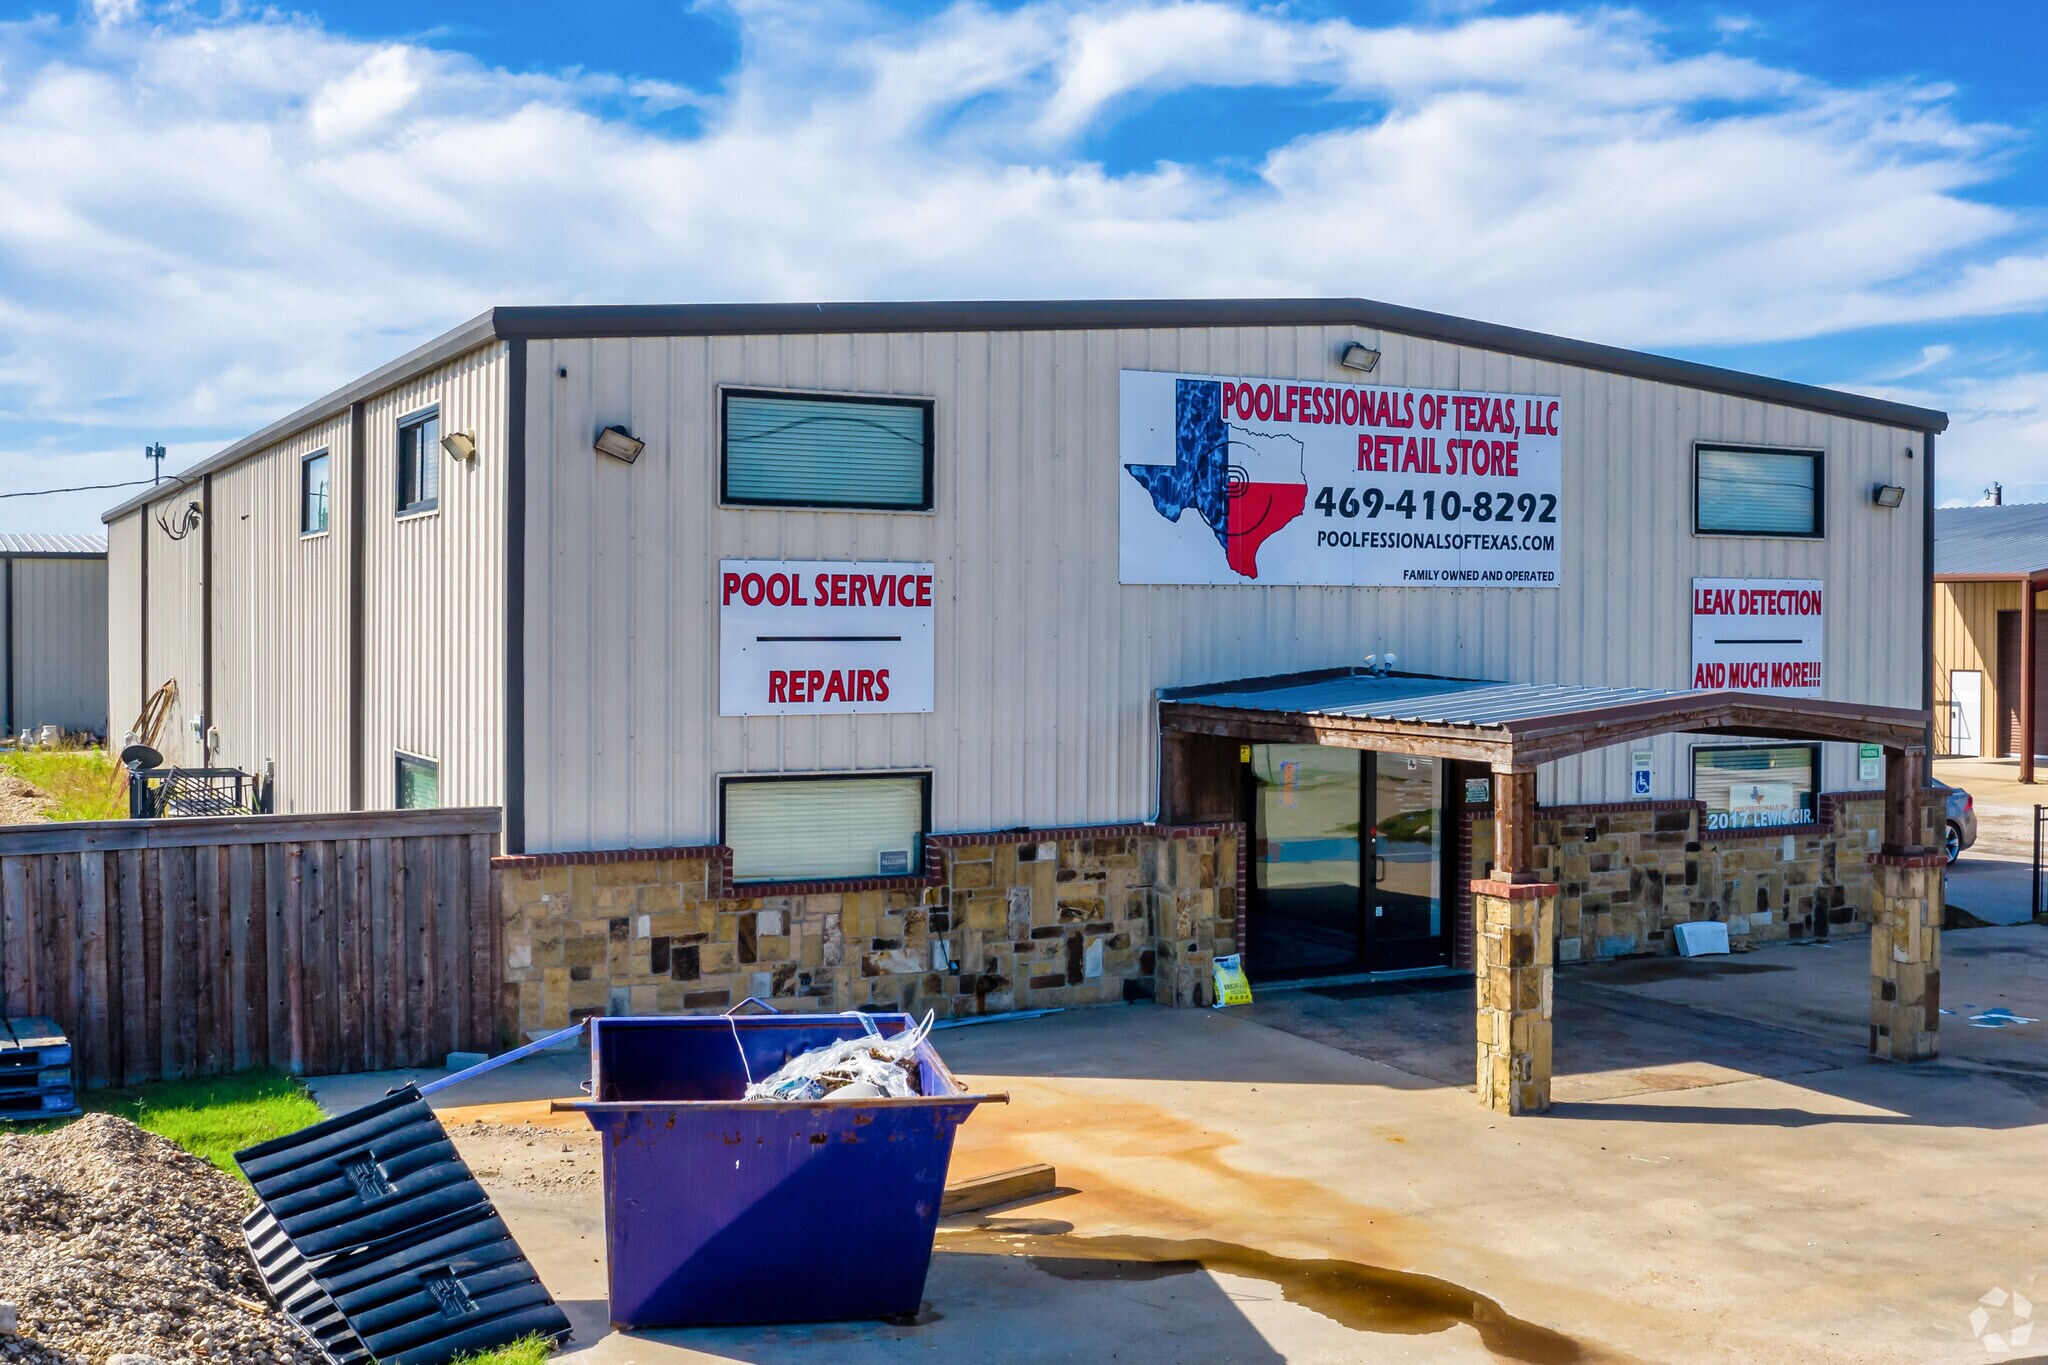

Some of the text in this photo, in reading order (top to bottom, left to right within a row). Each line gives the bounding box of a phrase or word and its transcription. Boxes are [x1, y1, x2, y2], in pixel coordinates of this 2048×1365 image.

[1222, 382, 1559, 440] POOLFESSIONALS OF TEXAS, LLC
[1357, 434, 1519, 477] RETAIL STORE
[1314, 486, 1557, 523] 469-410-8292
[1317, 531, 1555, 551] POOLFESSIONALSOFTEXAS.COM
[1403, 569, 1555, 581] FAMILY OWNED AND OPERATED
[722, 572, 932, 607] POOL SERVICE
[1694, 589, 1822, 616] LEAK DETECTION
[768, 669, 890, 703] REPAIRS
[1694, 661, 1821, 689] AND MUCH MORE!!!
[1862, 749, 1878, 757] PARKING
[1708, 808, 1814, 830] 2017 LEWIS CIR.
[1733, 805, 1780, 813] POOLFESSIONALS
